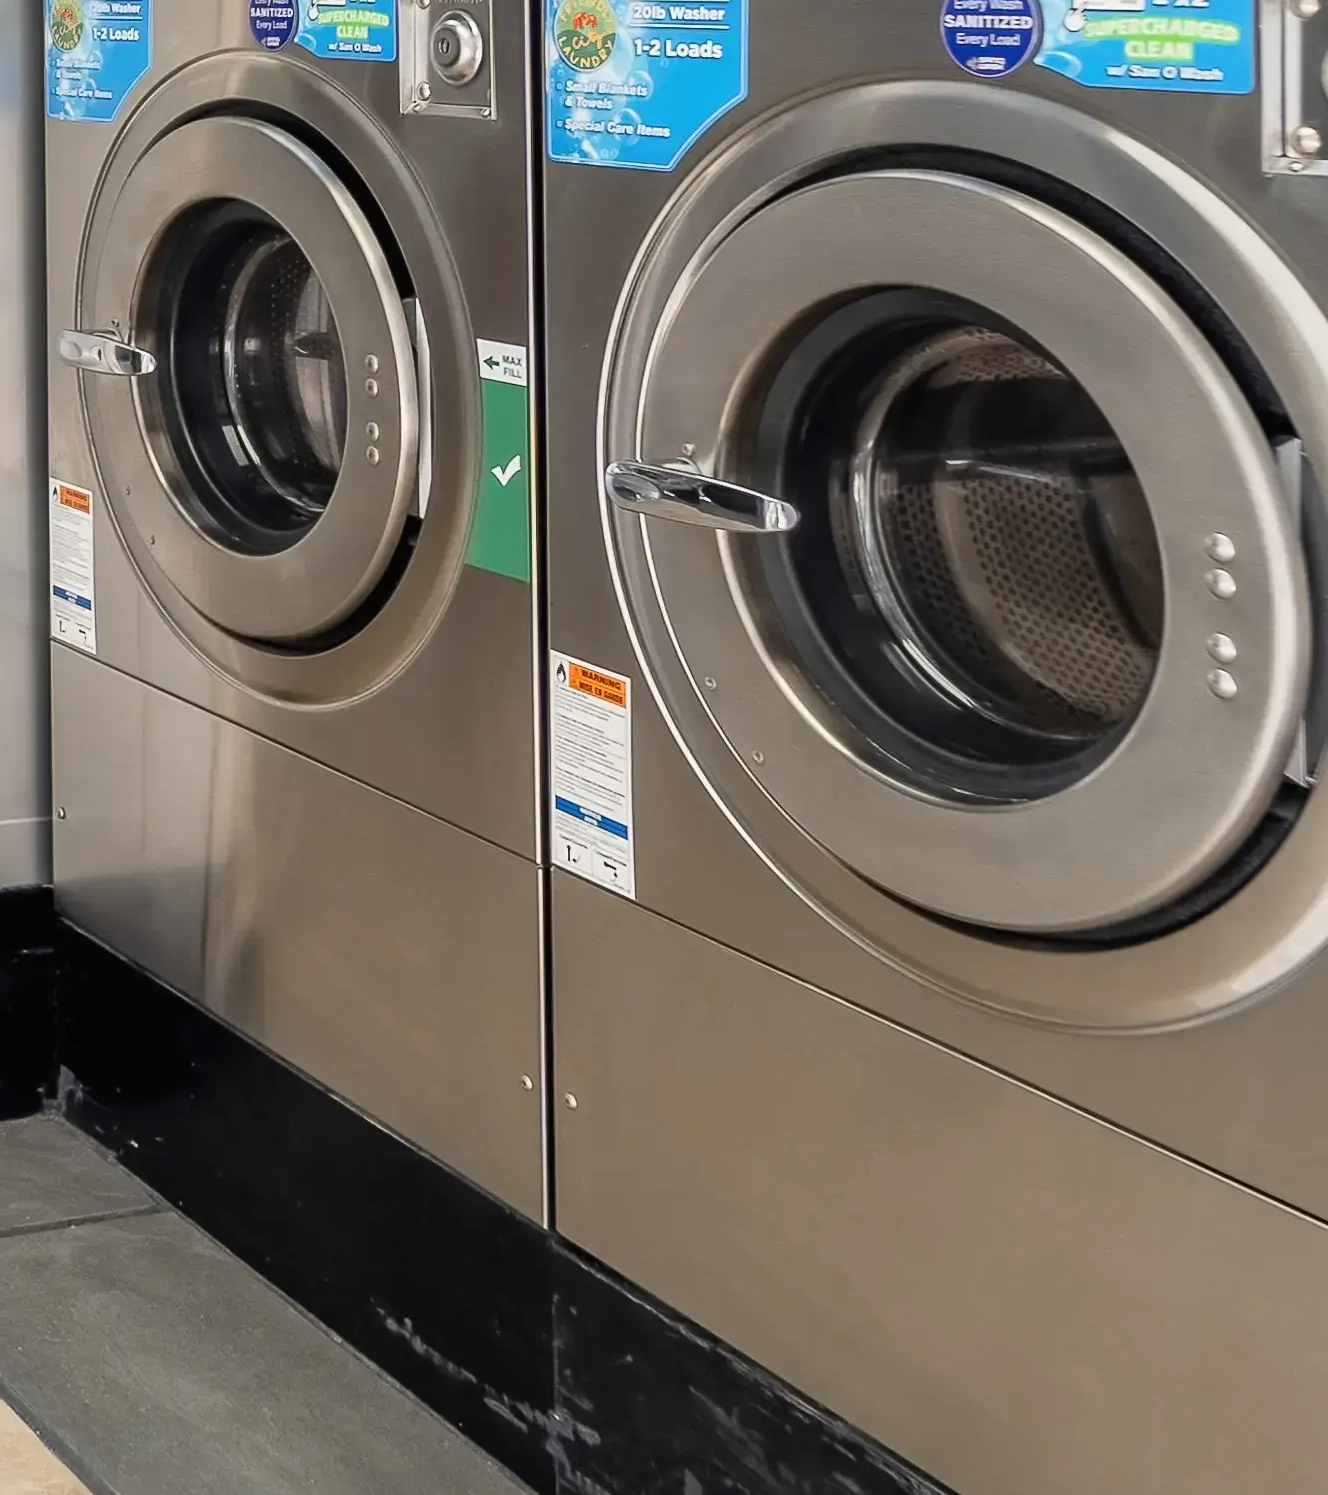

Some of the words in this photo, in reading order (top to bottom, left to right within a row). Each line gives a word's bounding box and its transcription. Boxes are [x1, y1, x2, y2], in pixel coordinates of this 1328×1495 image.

[110, 2, 141, 14] Washer
[250, 8, 294, 17] SANITIZED
[633, 6, 666, 20] 20lb
[669, 6, 726, 21] Washer
[944, 14, 1033, 29] SANITIZED
[1085, 16, 1239, 41] SUPERCHARGED
[109, 28, 140, 41] Loads
[956, 32, 989, 47] Every
[989, 33, 1021, 46] Load
[558, 36, 613, 68] LAUNDRY
[634, 39, 661, 57] 1-2
[666, 40, 724, 59] Loads
[565, 81, 595, 93] Small
[598, 82, 648, 96] Blankets
[576, 97, 613, 109] Towels
[565, 118, 604, 133] Special
[607, 121, 633, 134] Care
[637, 124, 671, 138] Items
[502, 355, 522, 367] MAX
[503, 367, 523, 379] FILL
[581, 669, 621, 691] WARNING
